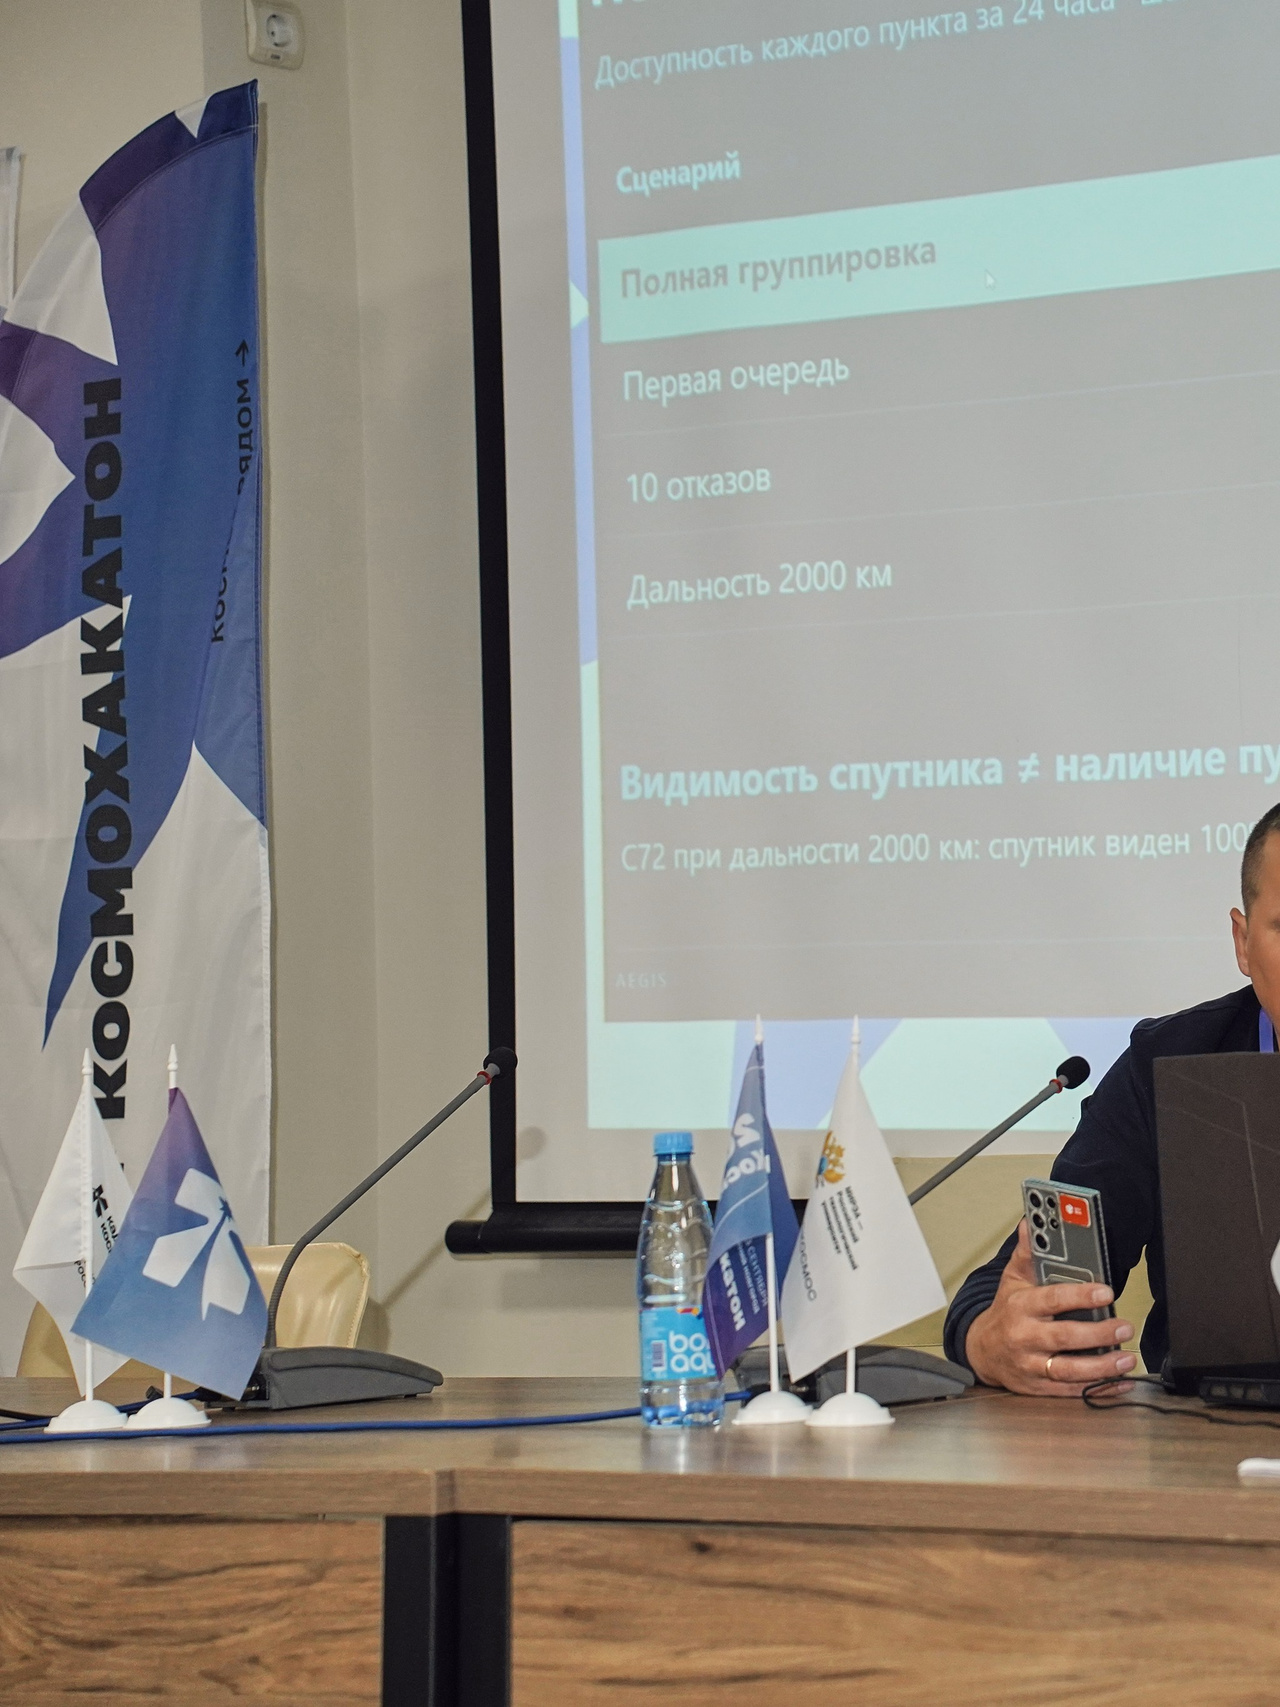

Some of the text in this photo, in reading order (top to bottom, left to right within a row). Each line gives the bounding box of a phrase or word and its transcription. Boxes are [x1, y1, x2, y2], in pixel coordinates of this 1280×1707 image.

[595, 42, 753, 90] Доступность
[762, 25, 870, 61] каждого
[879, 11, 968, 50] пункта
[976, 6, 1003, 30] за
[1013, 0, 1044, 25] 24
[616, 150, 742, 196] Сценарий
[620, 241, 938, 299] Полная группировка
[623, 357, 850, 408] Первая очередь
[626, 467, 772, 503] 10 отказов
[626, 560, 893, 611] Дальность 2000 км
[80, 377, 134, 1120] КОСМОХАКАТОН
[620, 762, 819, 806] Видимость
[829, 757, 1003, 801] спутника
[1055, 746, 1226, 782] наличие
[674, 844, 722, 876] при
[728, 840, 860, 872] дальности
[868, 834, 930, 864] 2000
[939, 836, 980, 861] км:
[988, 832, 1097, 867] спутник
[1105, 831, 1190, 858] виден
[1201, 821, 1257, 853] 100
